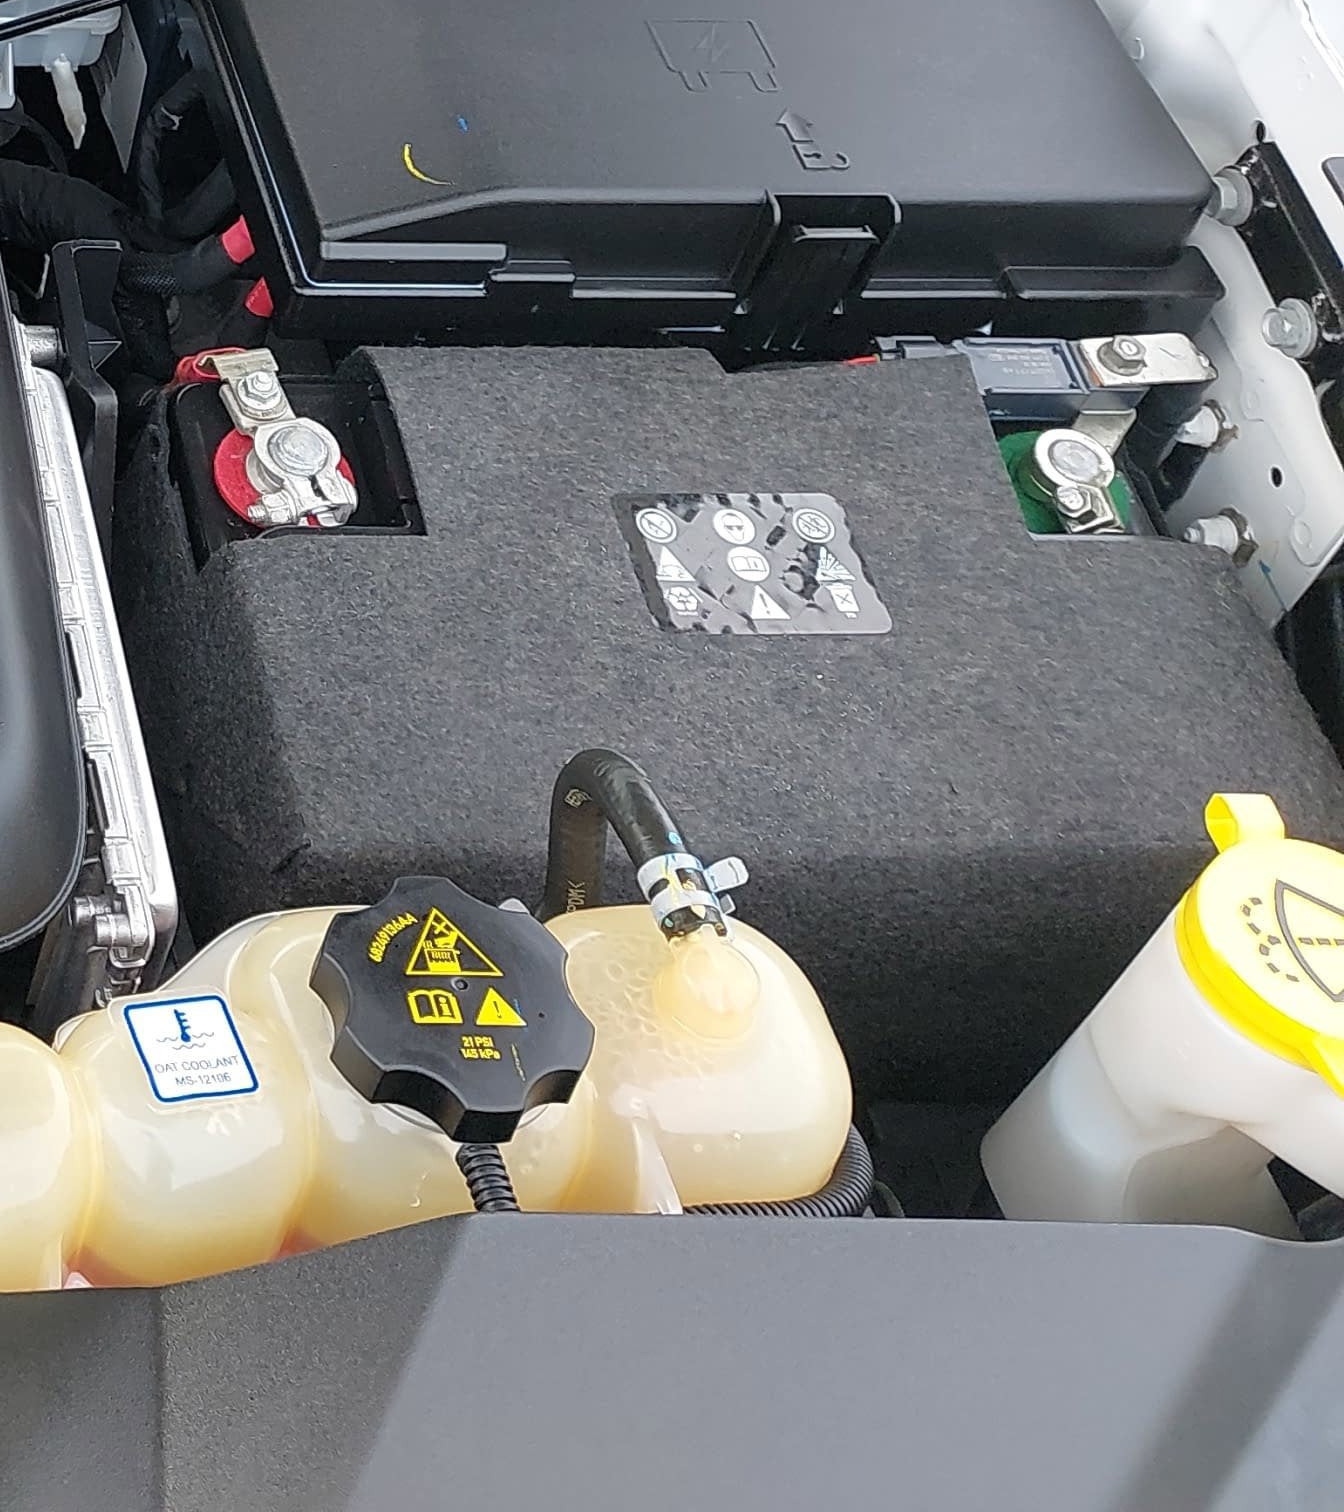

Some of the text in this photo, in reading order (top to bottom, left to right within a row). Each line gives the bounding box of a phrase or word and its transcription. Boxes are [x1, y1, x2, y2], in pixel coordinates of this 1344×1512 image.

[368, 911, 419, 963] 68249136AA
[461, 1036, 494, 1048] 21 PSI
[461, 1048, 501, 1060] 145 kPa
[154, 1054, 240, 1074] OAT COOLANT
[174, 1071, 232, 1086] MS-12106
